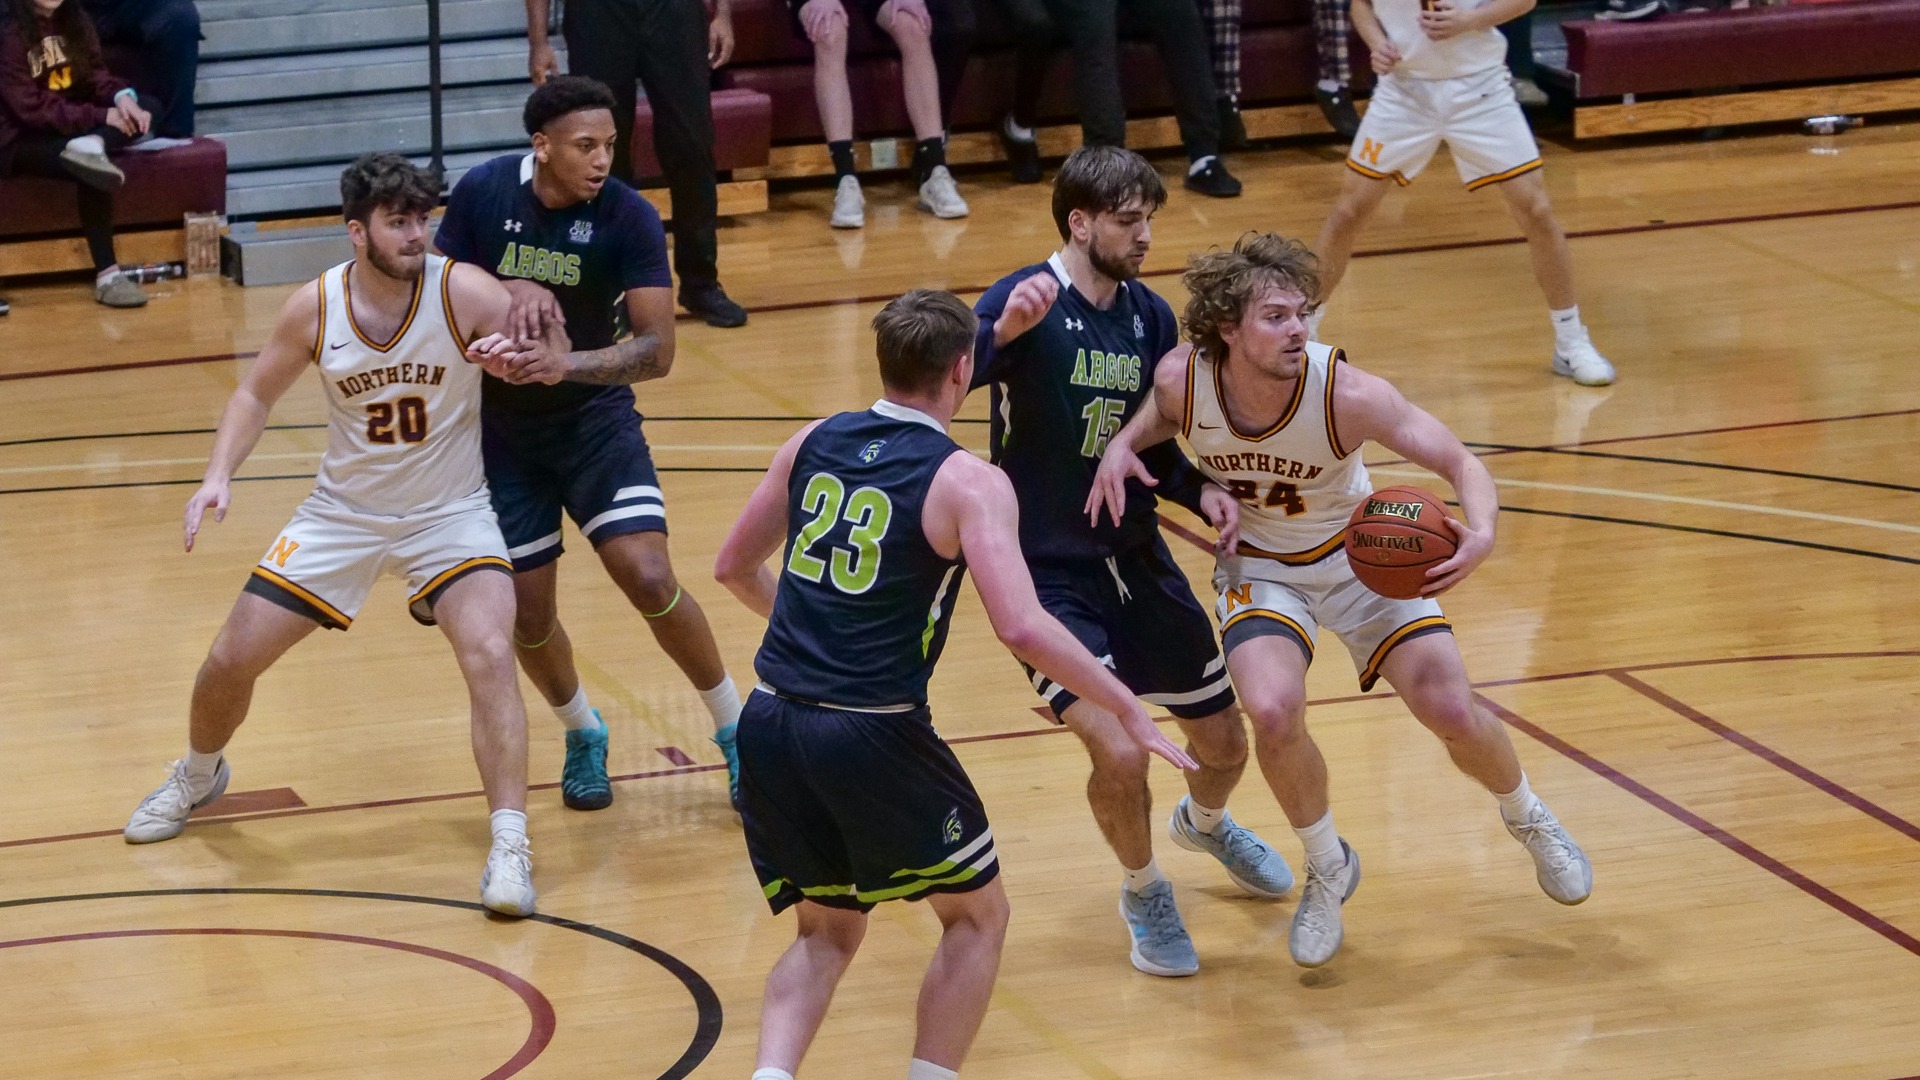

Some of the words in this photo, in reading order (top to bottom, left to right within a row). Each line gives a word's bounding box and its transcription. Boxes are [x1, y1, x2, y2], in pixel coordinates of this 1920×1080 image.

[1359, 137, 1384, 165] N
[496, 241, 581, 286] ARGOS
[336, 362, 447, 399] NORTHERN
[1069, 348, 1142, 392] ARGOS
[365, 396, 428, 445] 20
[1080, 396, 1126, 460] 15
[1200, 452, 1324, 480] NORTHERN
[1363, 498, 1424, 522] NAIA
[787, 472, 893, 595] 23
[1352, 530, 1424, 554] SPALDING
[265, 535, 301, 568] N
[1225, 582, 1252, 614] N
